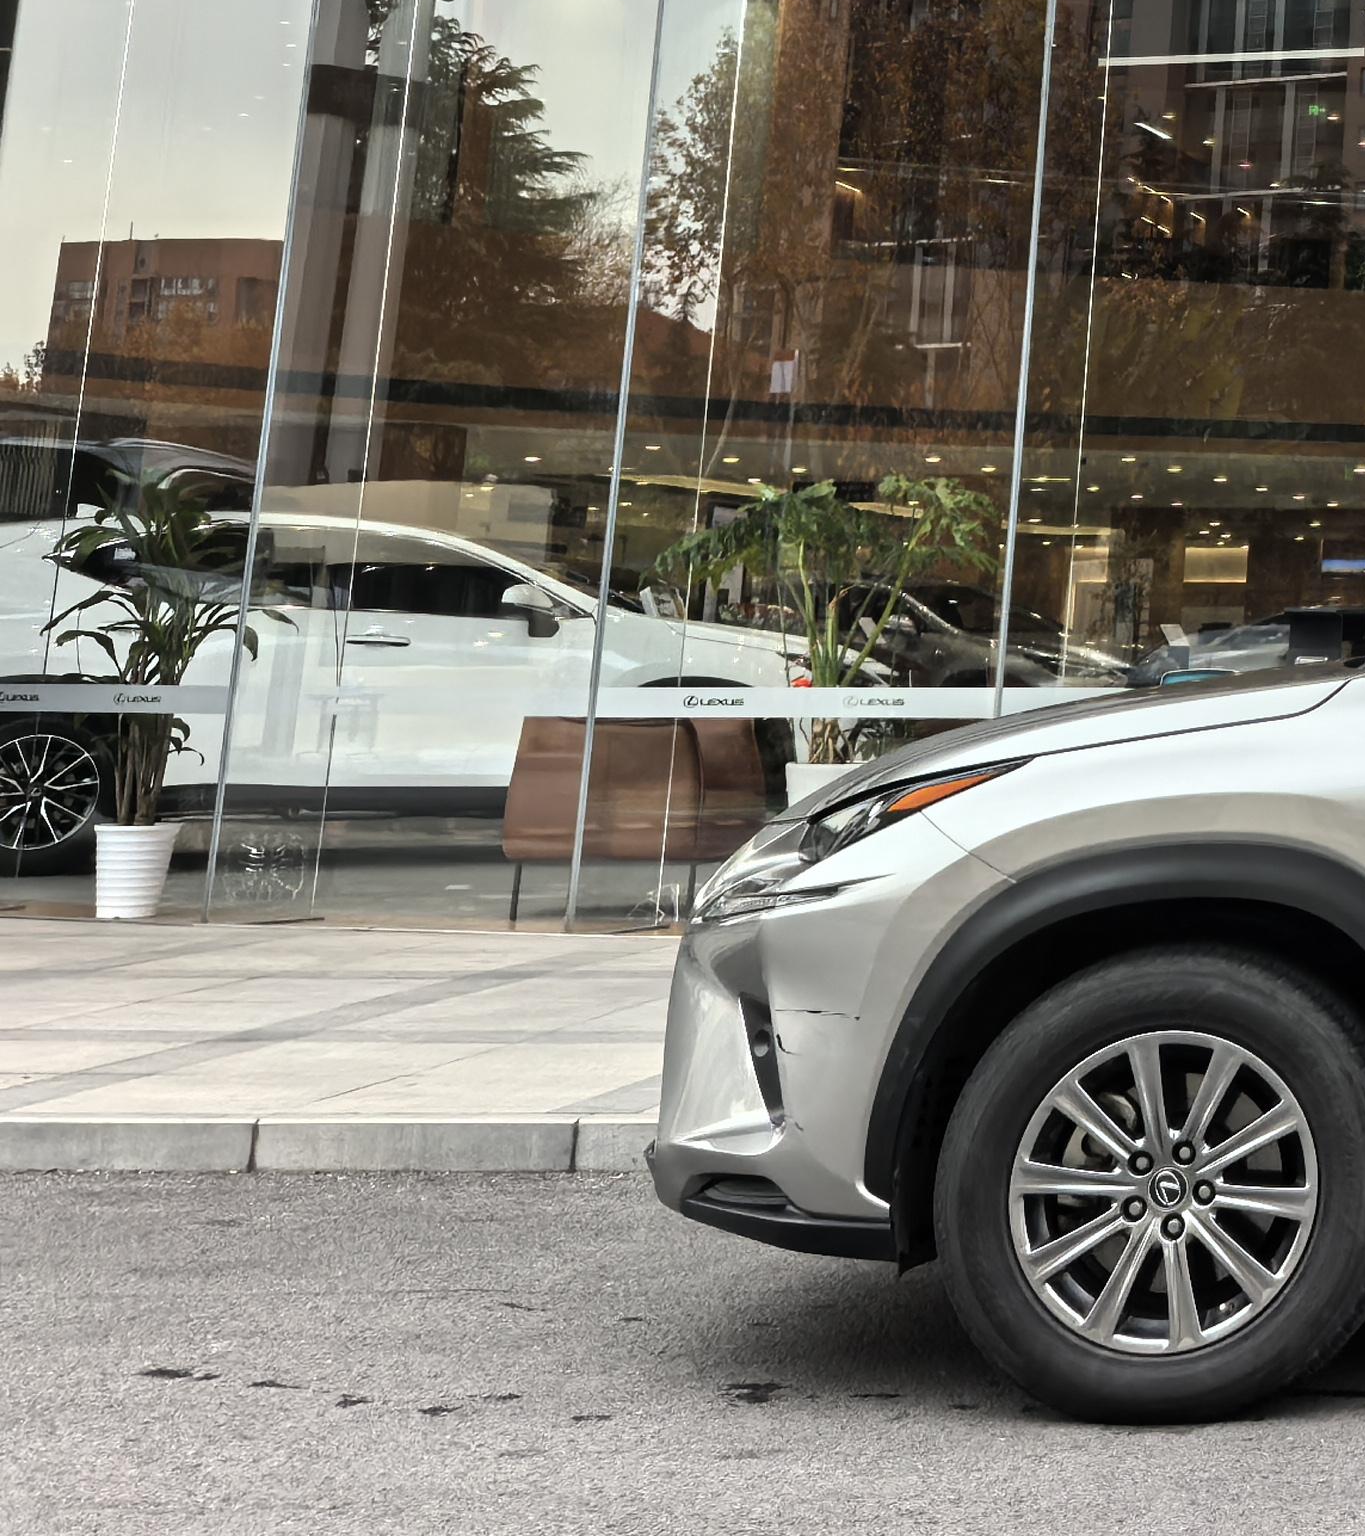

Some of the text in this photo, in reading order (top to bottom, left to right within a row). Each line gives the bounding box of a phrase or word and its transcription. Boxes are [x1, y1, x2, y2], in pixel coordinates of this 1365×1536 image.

[126, 695, 161, 703] LEXUS
[700, 697, 745, 706] LEXUS
[860, 698, 905, 706] LEXUS
